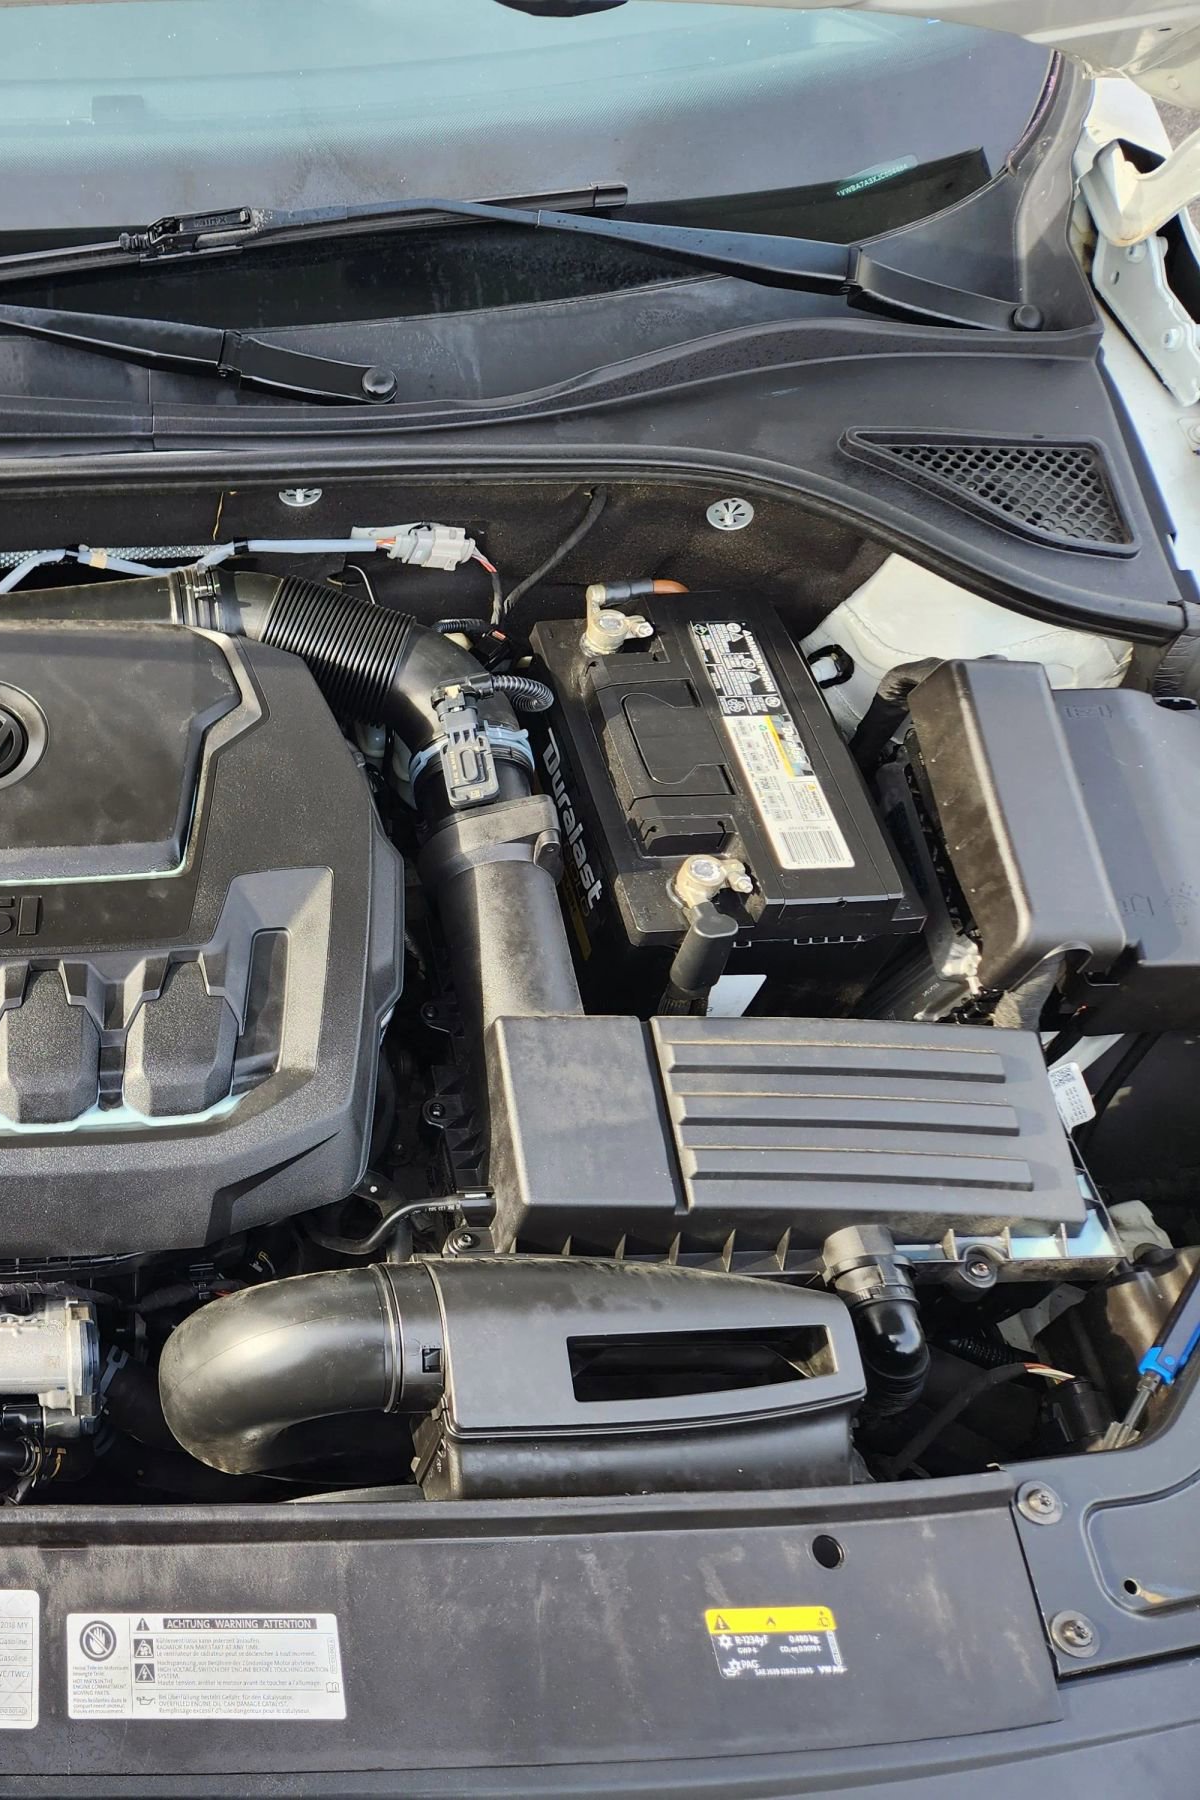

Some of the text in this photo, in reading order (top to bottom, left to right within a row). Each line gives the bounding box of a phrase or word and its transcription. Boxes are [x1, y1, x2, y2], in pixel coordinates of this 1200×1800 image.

[542, 727, 602, 910] Duralast
[17, 1621, 29, 1629] MY
[166, 1619, 311, 1629] ACHTUNG WARNING ATTENTION
[741, 1659, 760, 1669] PAG
